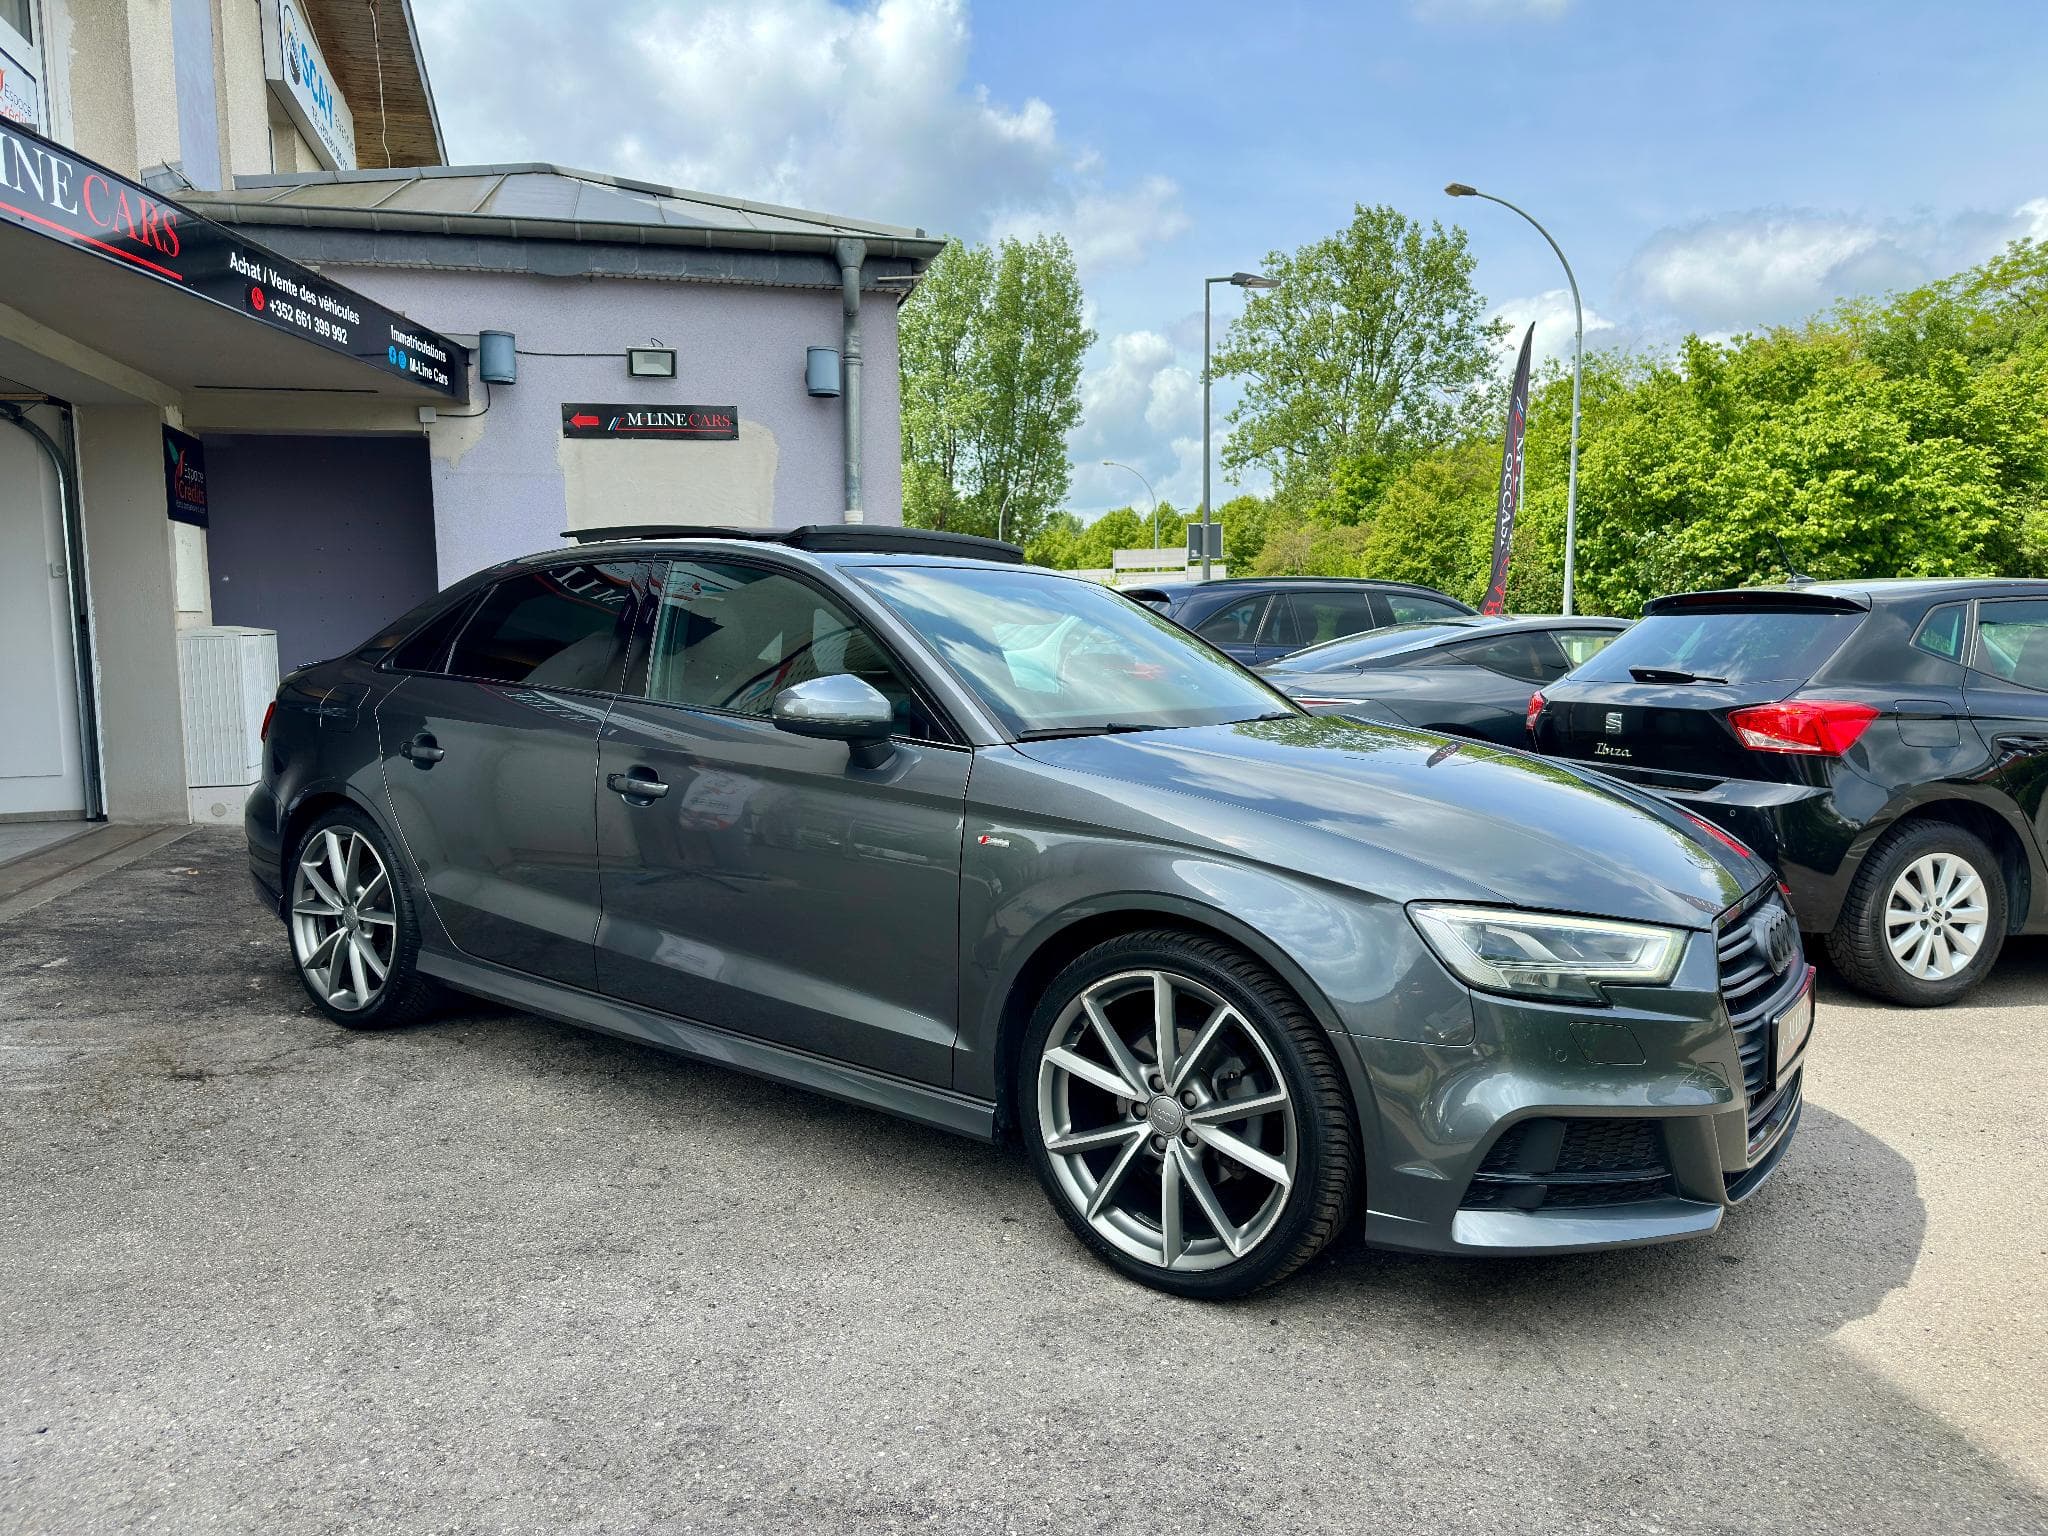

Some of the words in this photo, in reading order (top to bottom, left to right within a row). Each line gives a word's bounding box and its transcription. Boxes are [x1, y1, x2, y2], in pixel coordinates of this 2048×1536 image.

[301, 42, 333, 129] SCAY
[83, 174, 180, 258] CARS
[229, 251, 262, 282] Achat
[268, 268, 298, 297] Vente
[299, 284, 317, 306] des
[317, 295, 360, 325] véhicules
[269, 299, 294, 322] +352
[295, 308, 312, 330] 661
[314, 316, 331, 337] 399
[331, 324, 348, 345] 992
[390, 324, 447, 363] Immatriculations
[409, 357, 433, 380] M-Line
[433, 367, 449, 386] Cars
[627, 412, 688, 427] M-LINE
[688, 412, 731, 428] CARS
[1594, 742, 1633, 757] Ibiza
